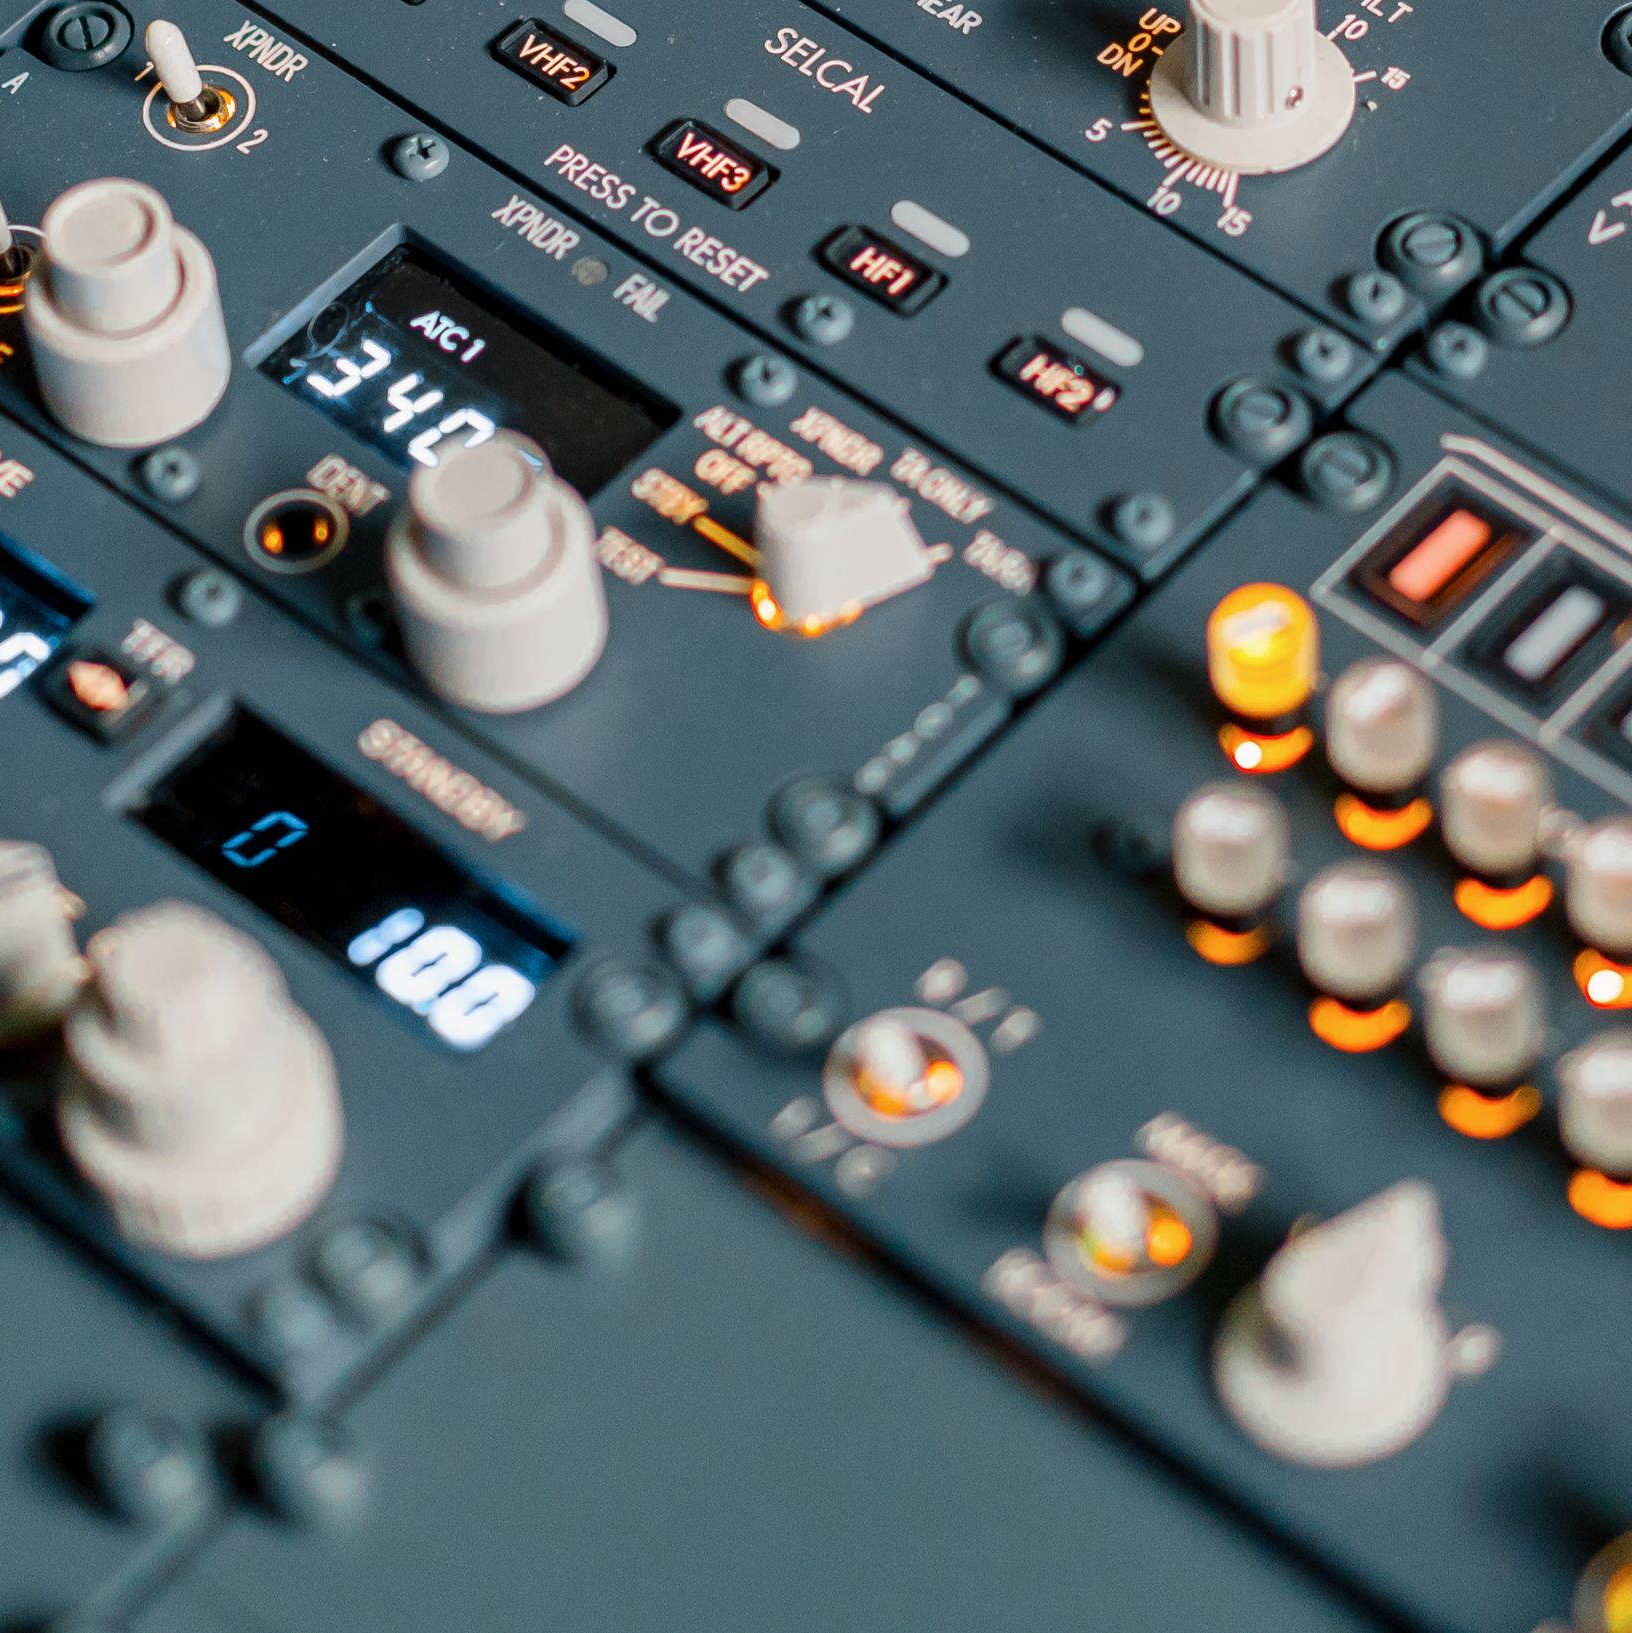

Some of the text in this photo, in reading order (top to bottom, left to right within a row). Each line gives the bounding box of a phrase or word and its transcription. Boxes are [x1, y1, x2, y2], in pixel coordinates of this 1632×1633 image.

[1138, 7, 1182, 36] UP
[1335, 13, 1369, 40] 10
[222, 19, 310, 84] XPNDR
[518, 32, 592, 91] VHF2
[764, 27, 886, 115] SELCAL
[1097, 43, 1144, 78] DN
[1379, 66, 1412, 91] 15
[235, 128, 270, 155] 2
[1084, 118, 1114, 143] 5
[675, 132, 753, 194] VHF3
[543, 144, 770, 294] PRESS TO RESET
[1146, 185, 1184, 216] 10
[1215, 206, 1253, 237] 15
[490, 196, 581, 261] XPNDR
[849, 245, 913, 296] HF1
[612, 273, 670, 325] FAIL
[410, 310, 487, 364] ATC 1
[1018, 354, 1095, 413] HF2
[221, 809, 311, 869] 0
